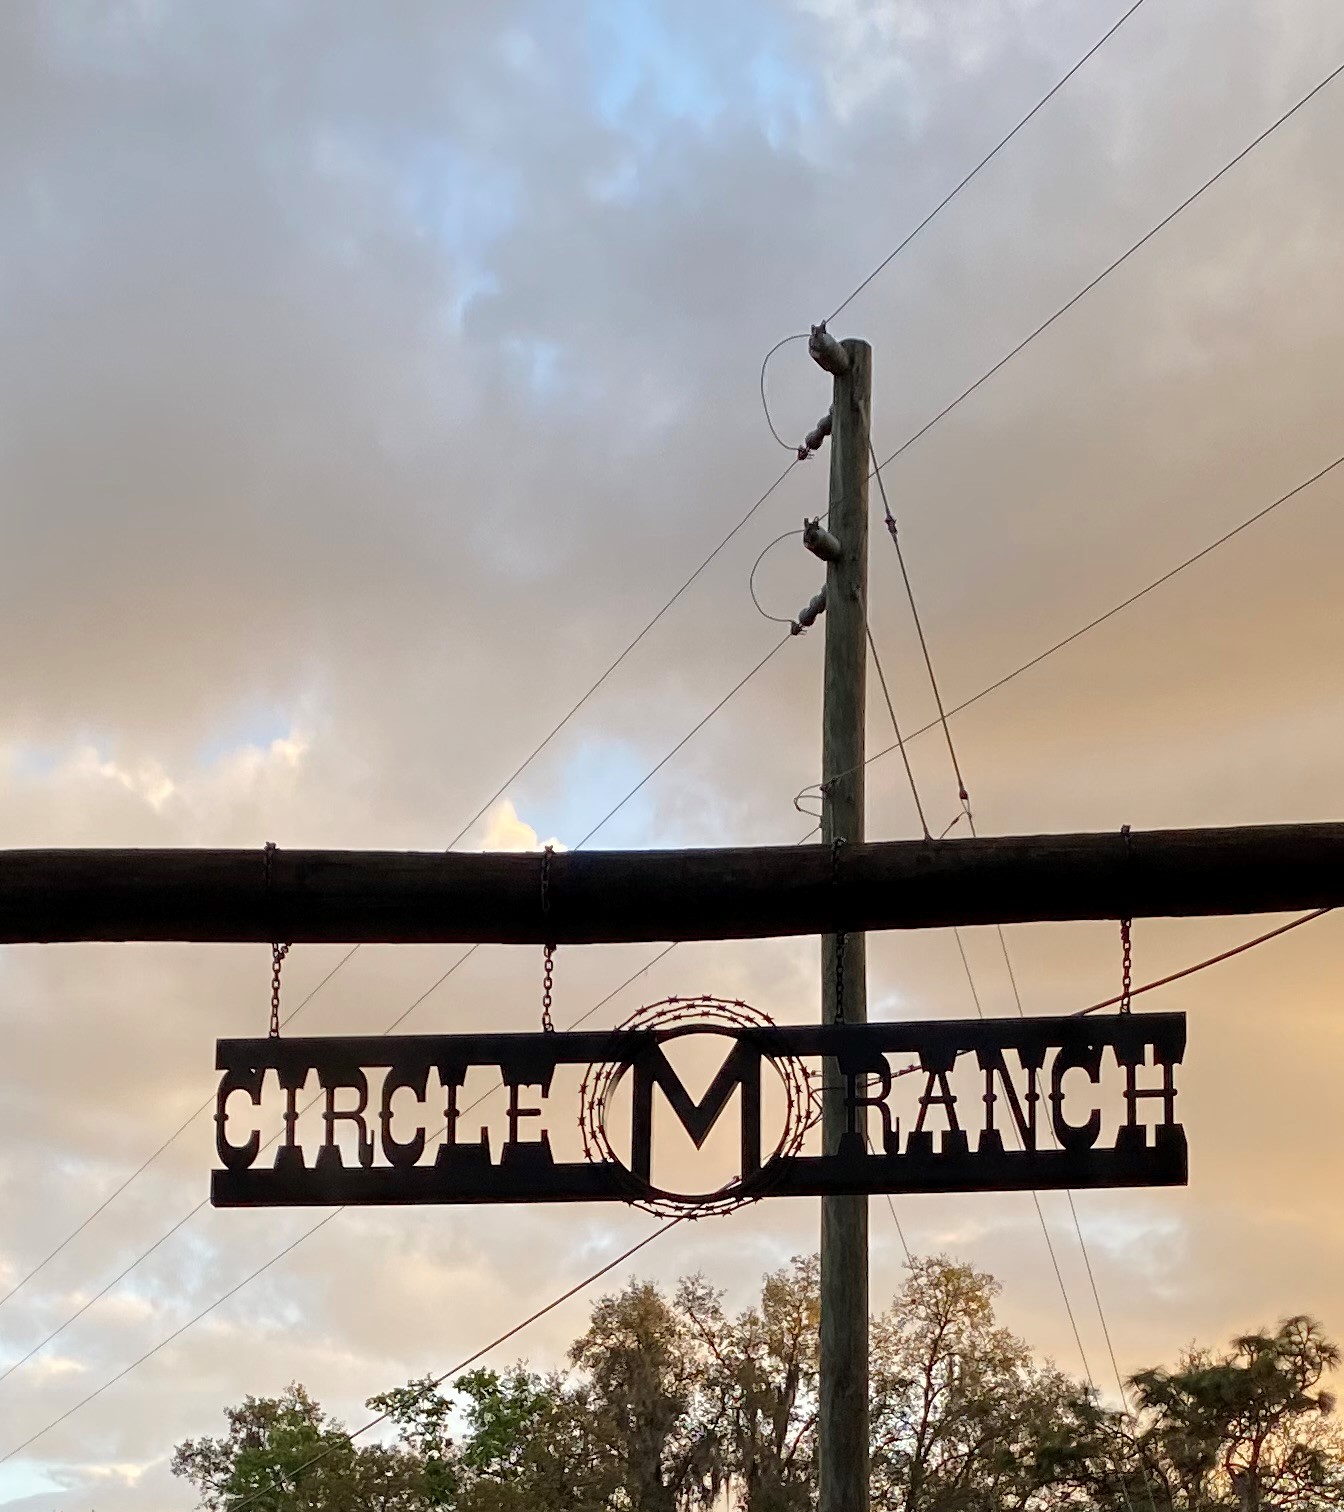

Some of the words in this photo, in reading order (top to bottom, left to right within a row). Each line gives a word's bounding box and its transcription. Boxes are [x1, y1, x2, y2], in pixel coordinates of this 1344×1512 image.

[212, 1054, 553, 1174] CIRCLE
[629, 1026, 764, 1200] M
[838, 1042, 1178, 1158] RANCH
